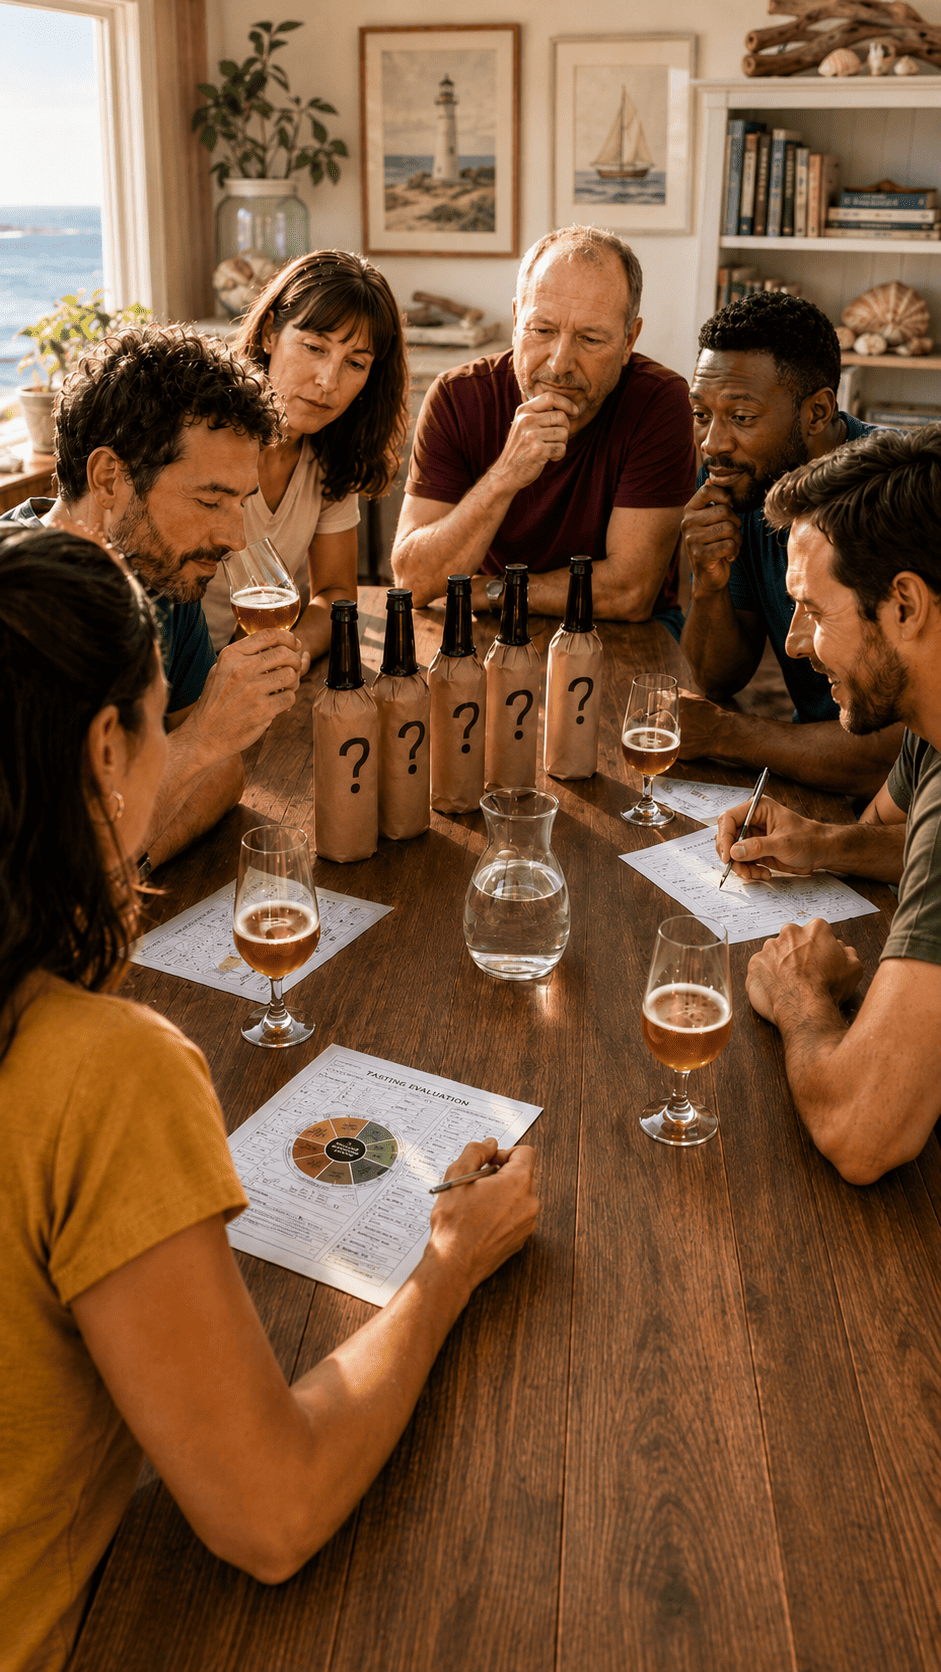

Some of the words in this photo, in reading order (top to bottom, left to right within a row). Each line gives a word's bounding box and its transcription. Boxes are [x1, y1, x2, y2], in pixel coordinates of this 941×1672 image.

[505, 689, 534, 740] ?
[568, 676, 594, 725] ?
[397, 720, 425, 775] ?
[452, 701, 480, 754] ?
[339, 737, 370, 794] ?
[366, 1070, 407, 1087] TASTING
[408, 1083, 470, 1107] EVALUATION
